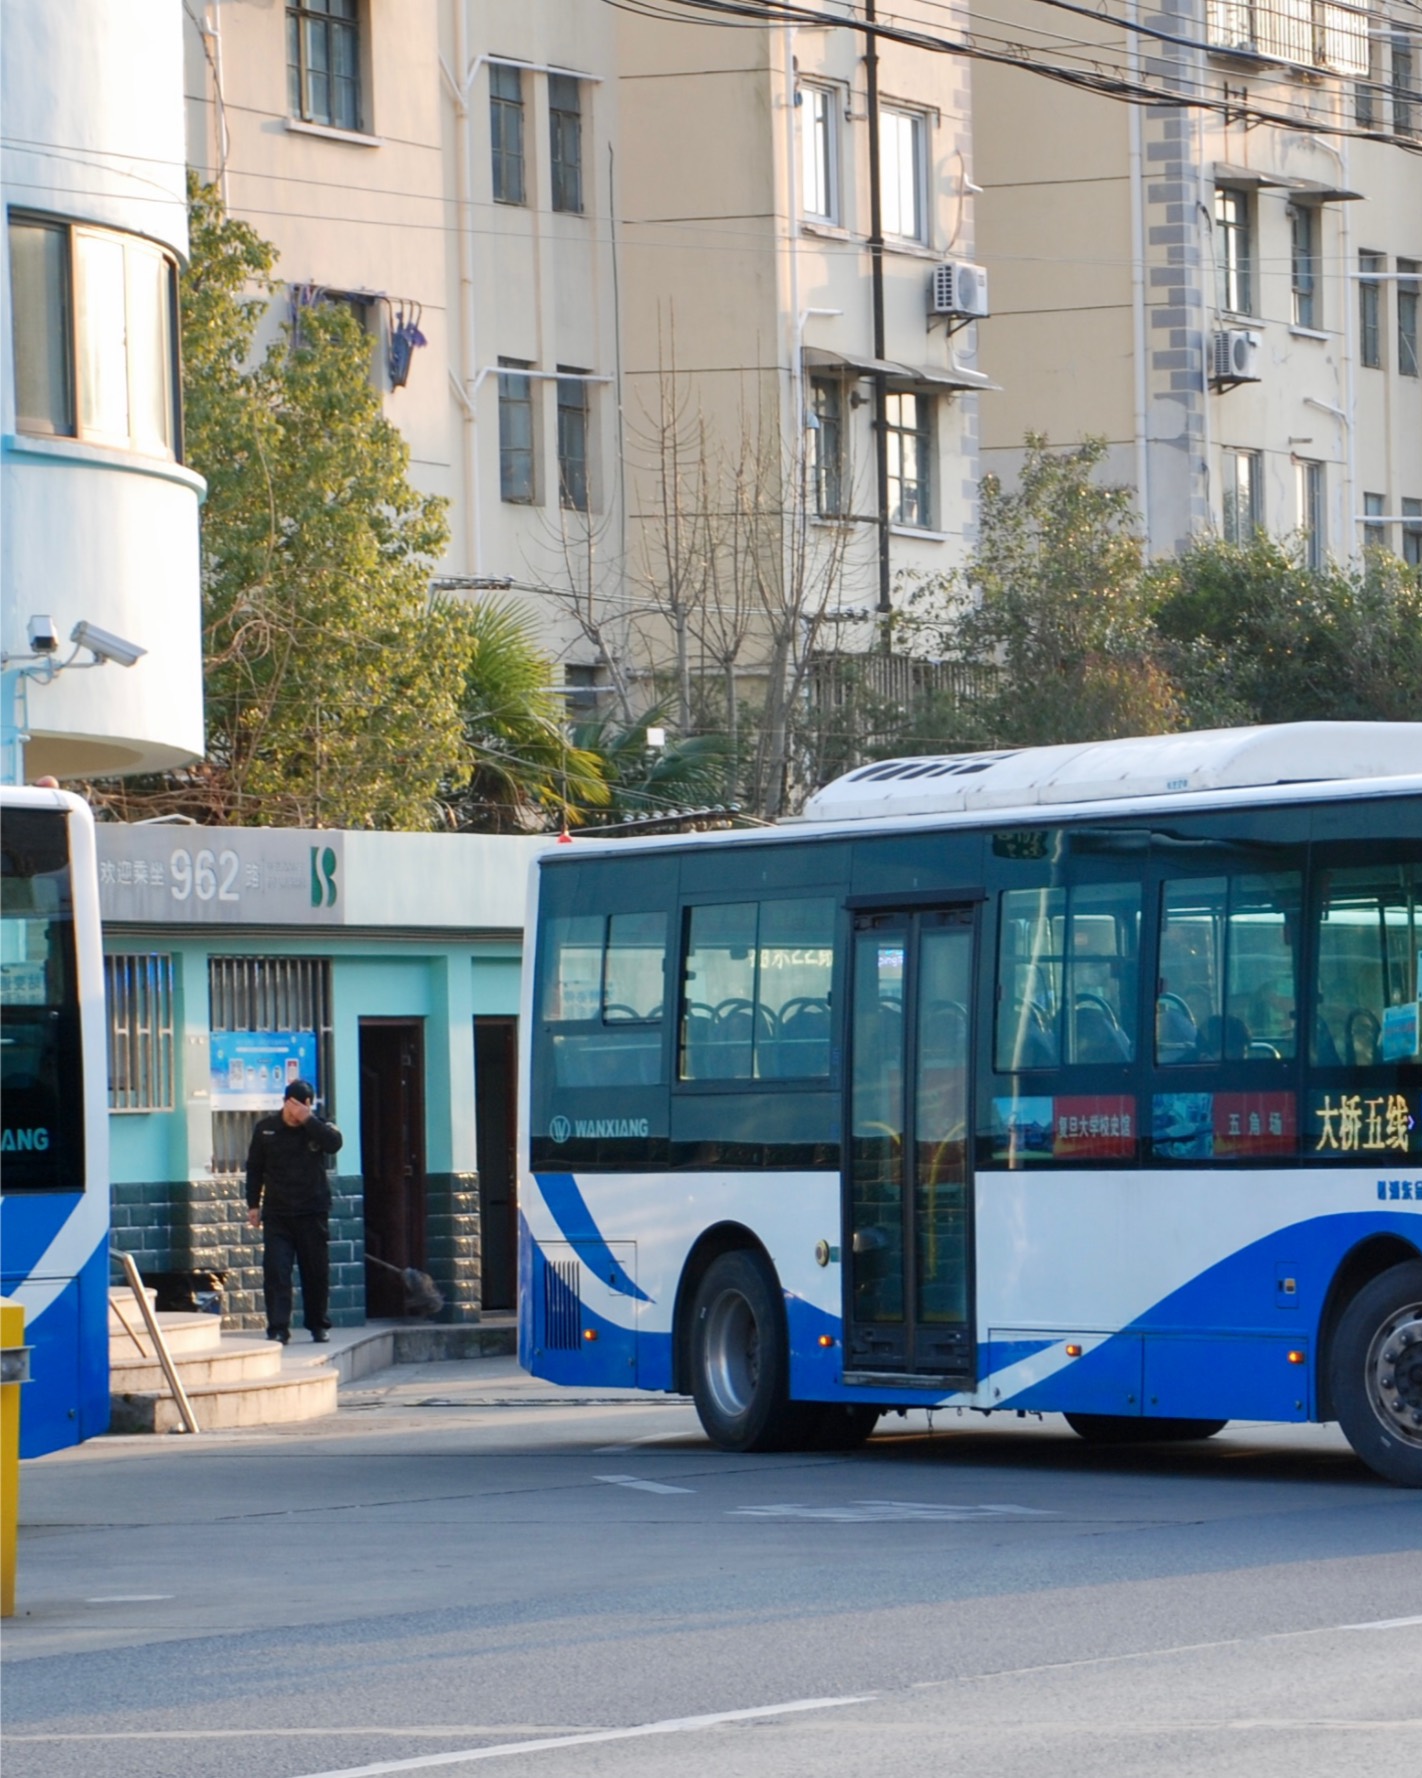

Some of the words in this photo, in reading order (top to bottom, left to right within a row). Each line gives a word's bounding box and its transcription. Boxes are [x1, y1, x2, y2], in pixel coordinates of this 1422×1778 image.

[171, 849, 240, 901] 962
[575, 1118, 648, 1138] WANXIANG
[1228, 1111, 1283, 1136] 五角场
[1315, 1094, 1409, 1152] 大桥五线
